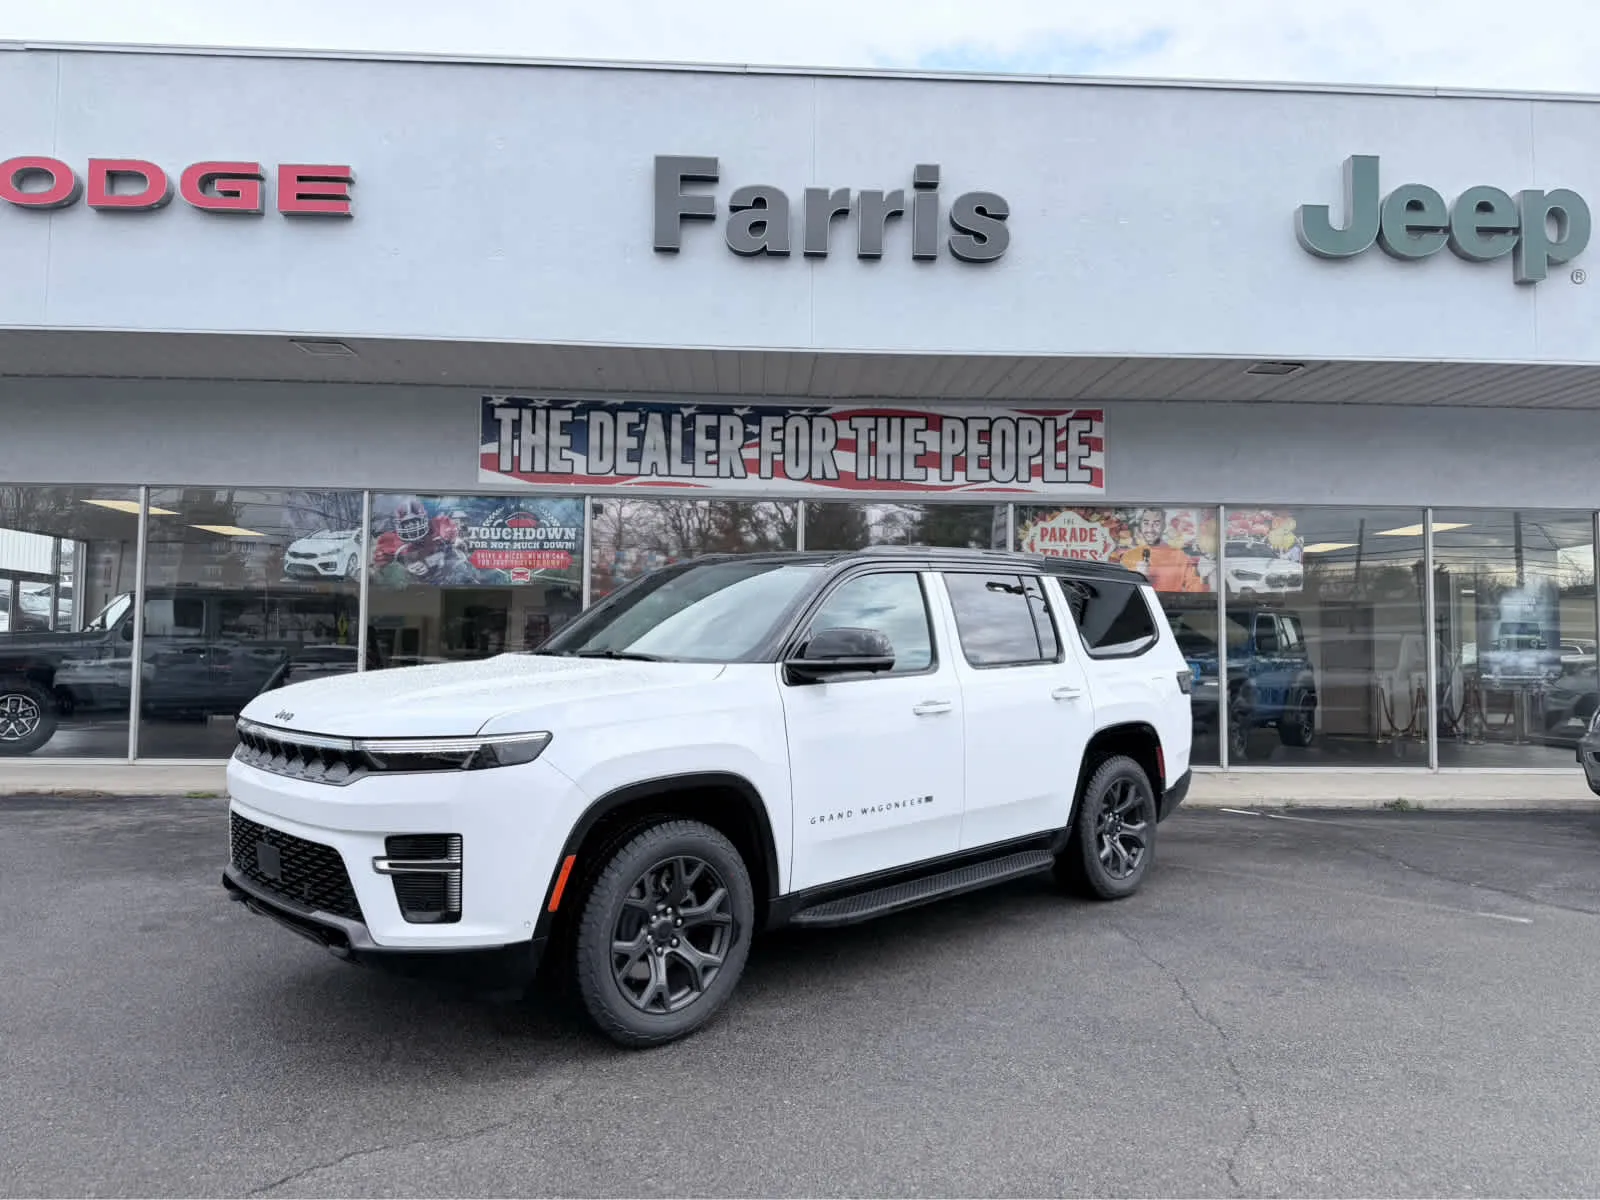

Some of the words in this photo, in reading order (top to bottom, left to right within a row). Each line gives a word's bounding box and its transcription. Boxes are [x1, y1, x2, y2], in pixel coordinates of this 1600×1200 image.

[654, 155, 1010, 263] Farris
[1295, 154, 1592, 285] Jeep
[494, 407, 575, 474] THE
[587, 408, 748, 479] DEALER
[759, 412, 840, 481] FOR
[850, 416, 928, 481] THE
[940, 417, 1093, 484] PEOPLE
[467, 527, 577, 540] TOUCHDOWN
[1040, 527, 1098, 543] PARADE
[469, 541, 488, 549] FOR
[490, 541, 510, 549] NOT
[513, 541, 540, 549] MUCH
[543, 541, 576, 550] DOWN!
[274, 709, 295, 722] Jeep
[809, 809, 853, 825] GRAND
